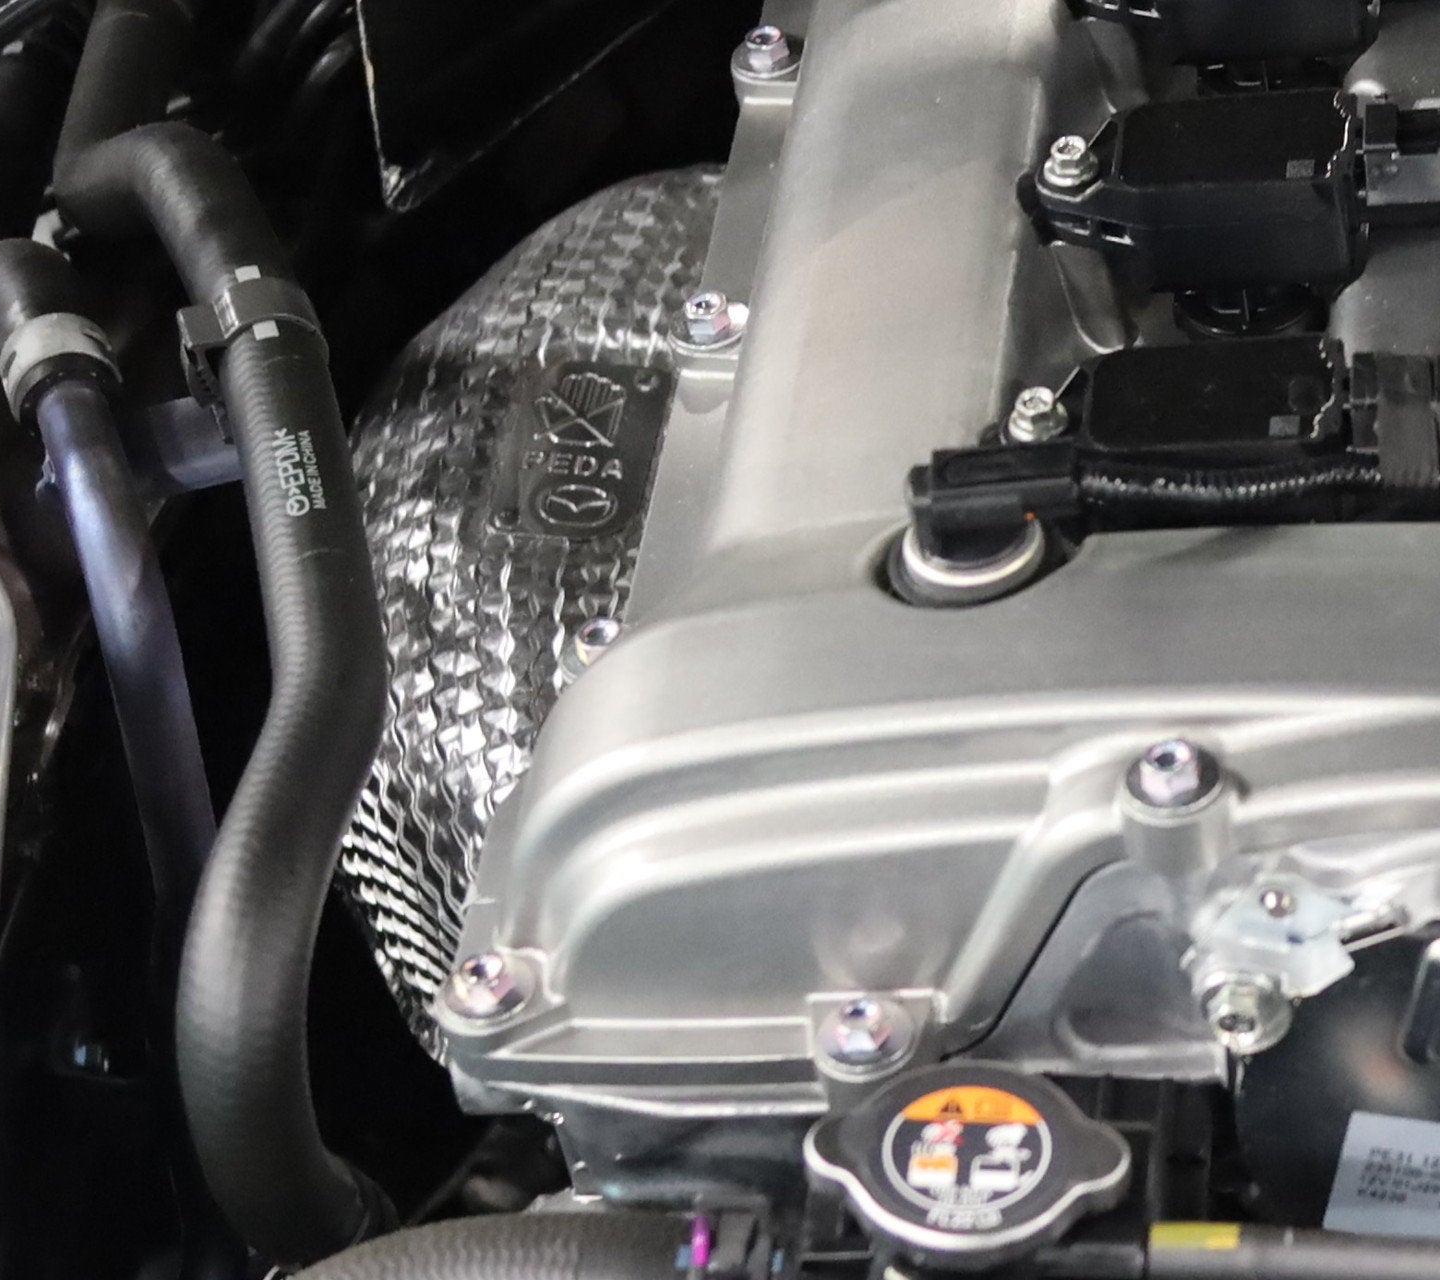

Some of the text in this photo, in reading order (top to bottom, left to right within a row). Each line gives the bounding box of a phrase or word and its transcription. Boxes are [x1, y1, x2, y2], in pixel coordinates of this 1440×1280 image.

[298, 430, 317, 464] CHINA
[521, 451, 624, 481] PEDA
[309, 477, 327, 509] MADE
